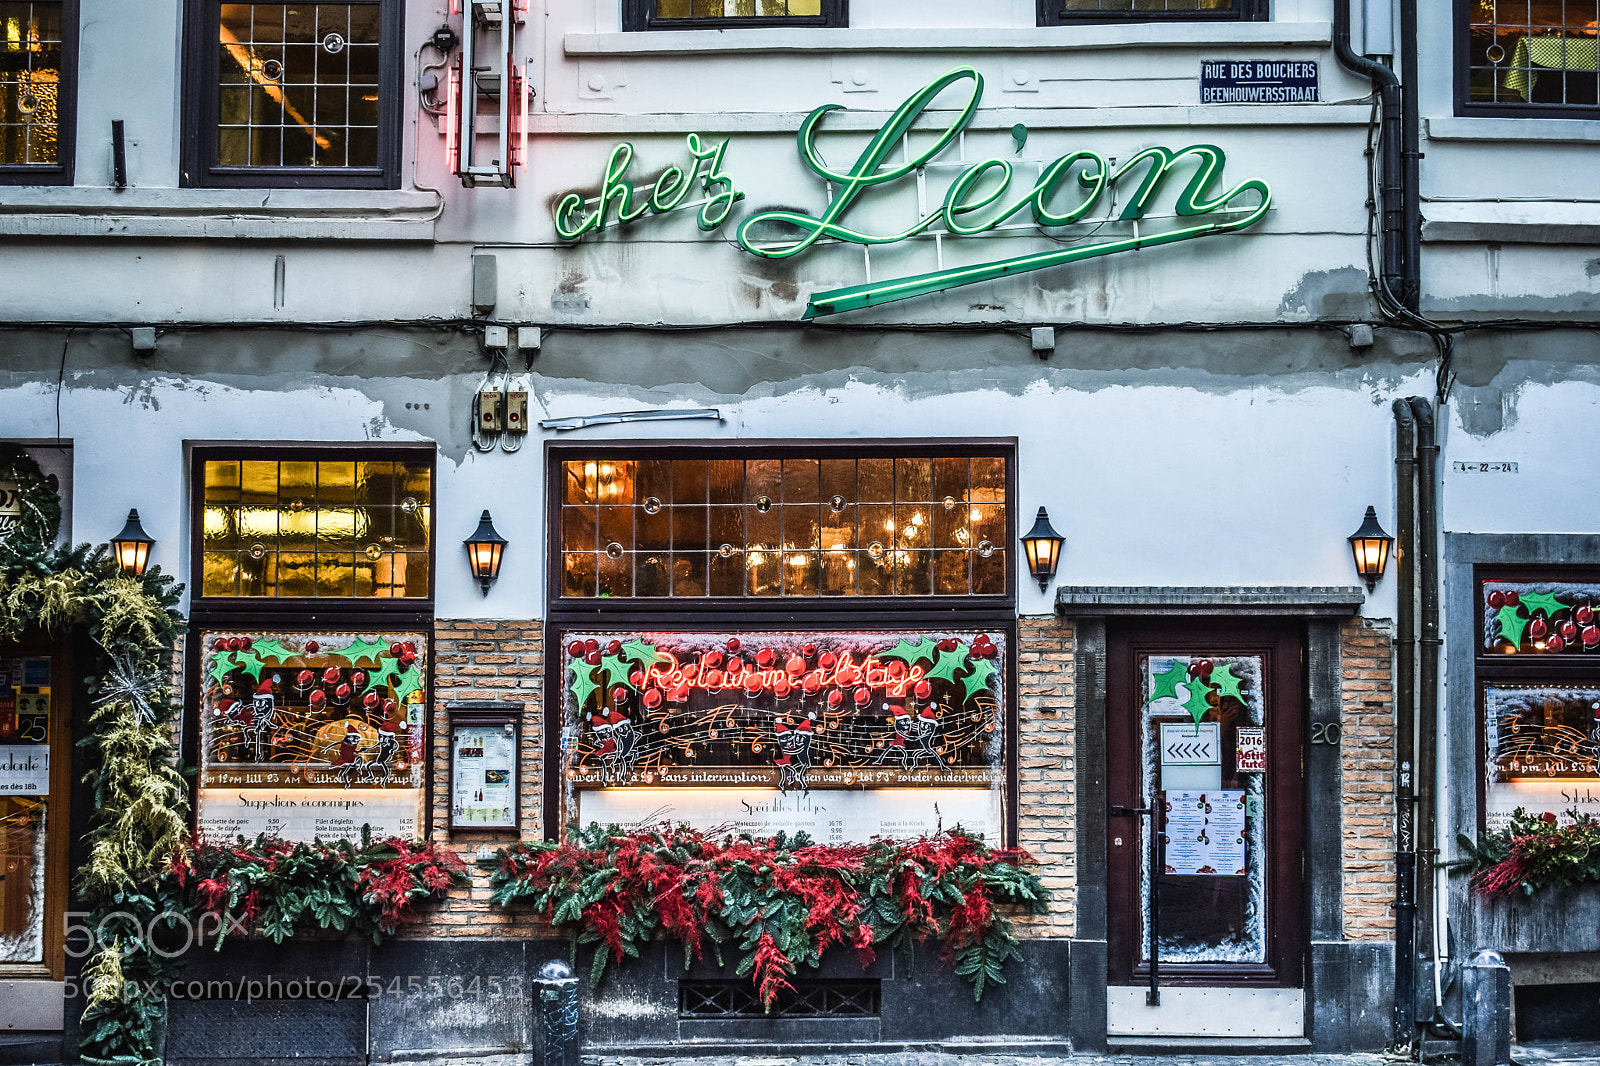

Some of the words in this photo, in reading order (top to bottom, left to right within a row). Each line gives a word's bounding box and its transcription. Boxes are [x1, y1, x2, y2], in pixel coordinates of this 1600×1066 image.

[1205, 64, 1226, 79] RUE
[1230, 64, 1252, 79] DES
[1256, 63, 1316, 79] BOUCHERS
[1203, 86, 1317, 102] BEENHOUWERSSTRAAT
[1480, 463, 1489, 472] 22
[1502, 463, 1512, 472] 24
[641, 651, 803, 690] Returnt
[21, 717, 47, 742] 25
[1311, 722, 1341, 745] 20
[1239, 736, 1263, 746] 2016
[660, 773, 688, 783] sans
[688, 771, 771, 784] interruption
[898, 771, 932, 782] zonder
[934, 771, 1007, 783] onderbrek
[237, 792, 297, 810] Suggestions
[301, 796, 364, 810] économiques
